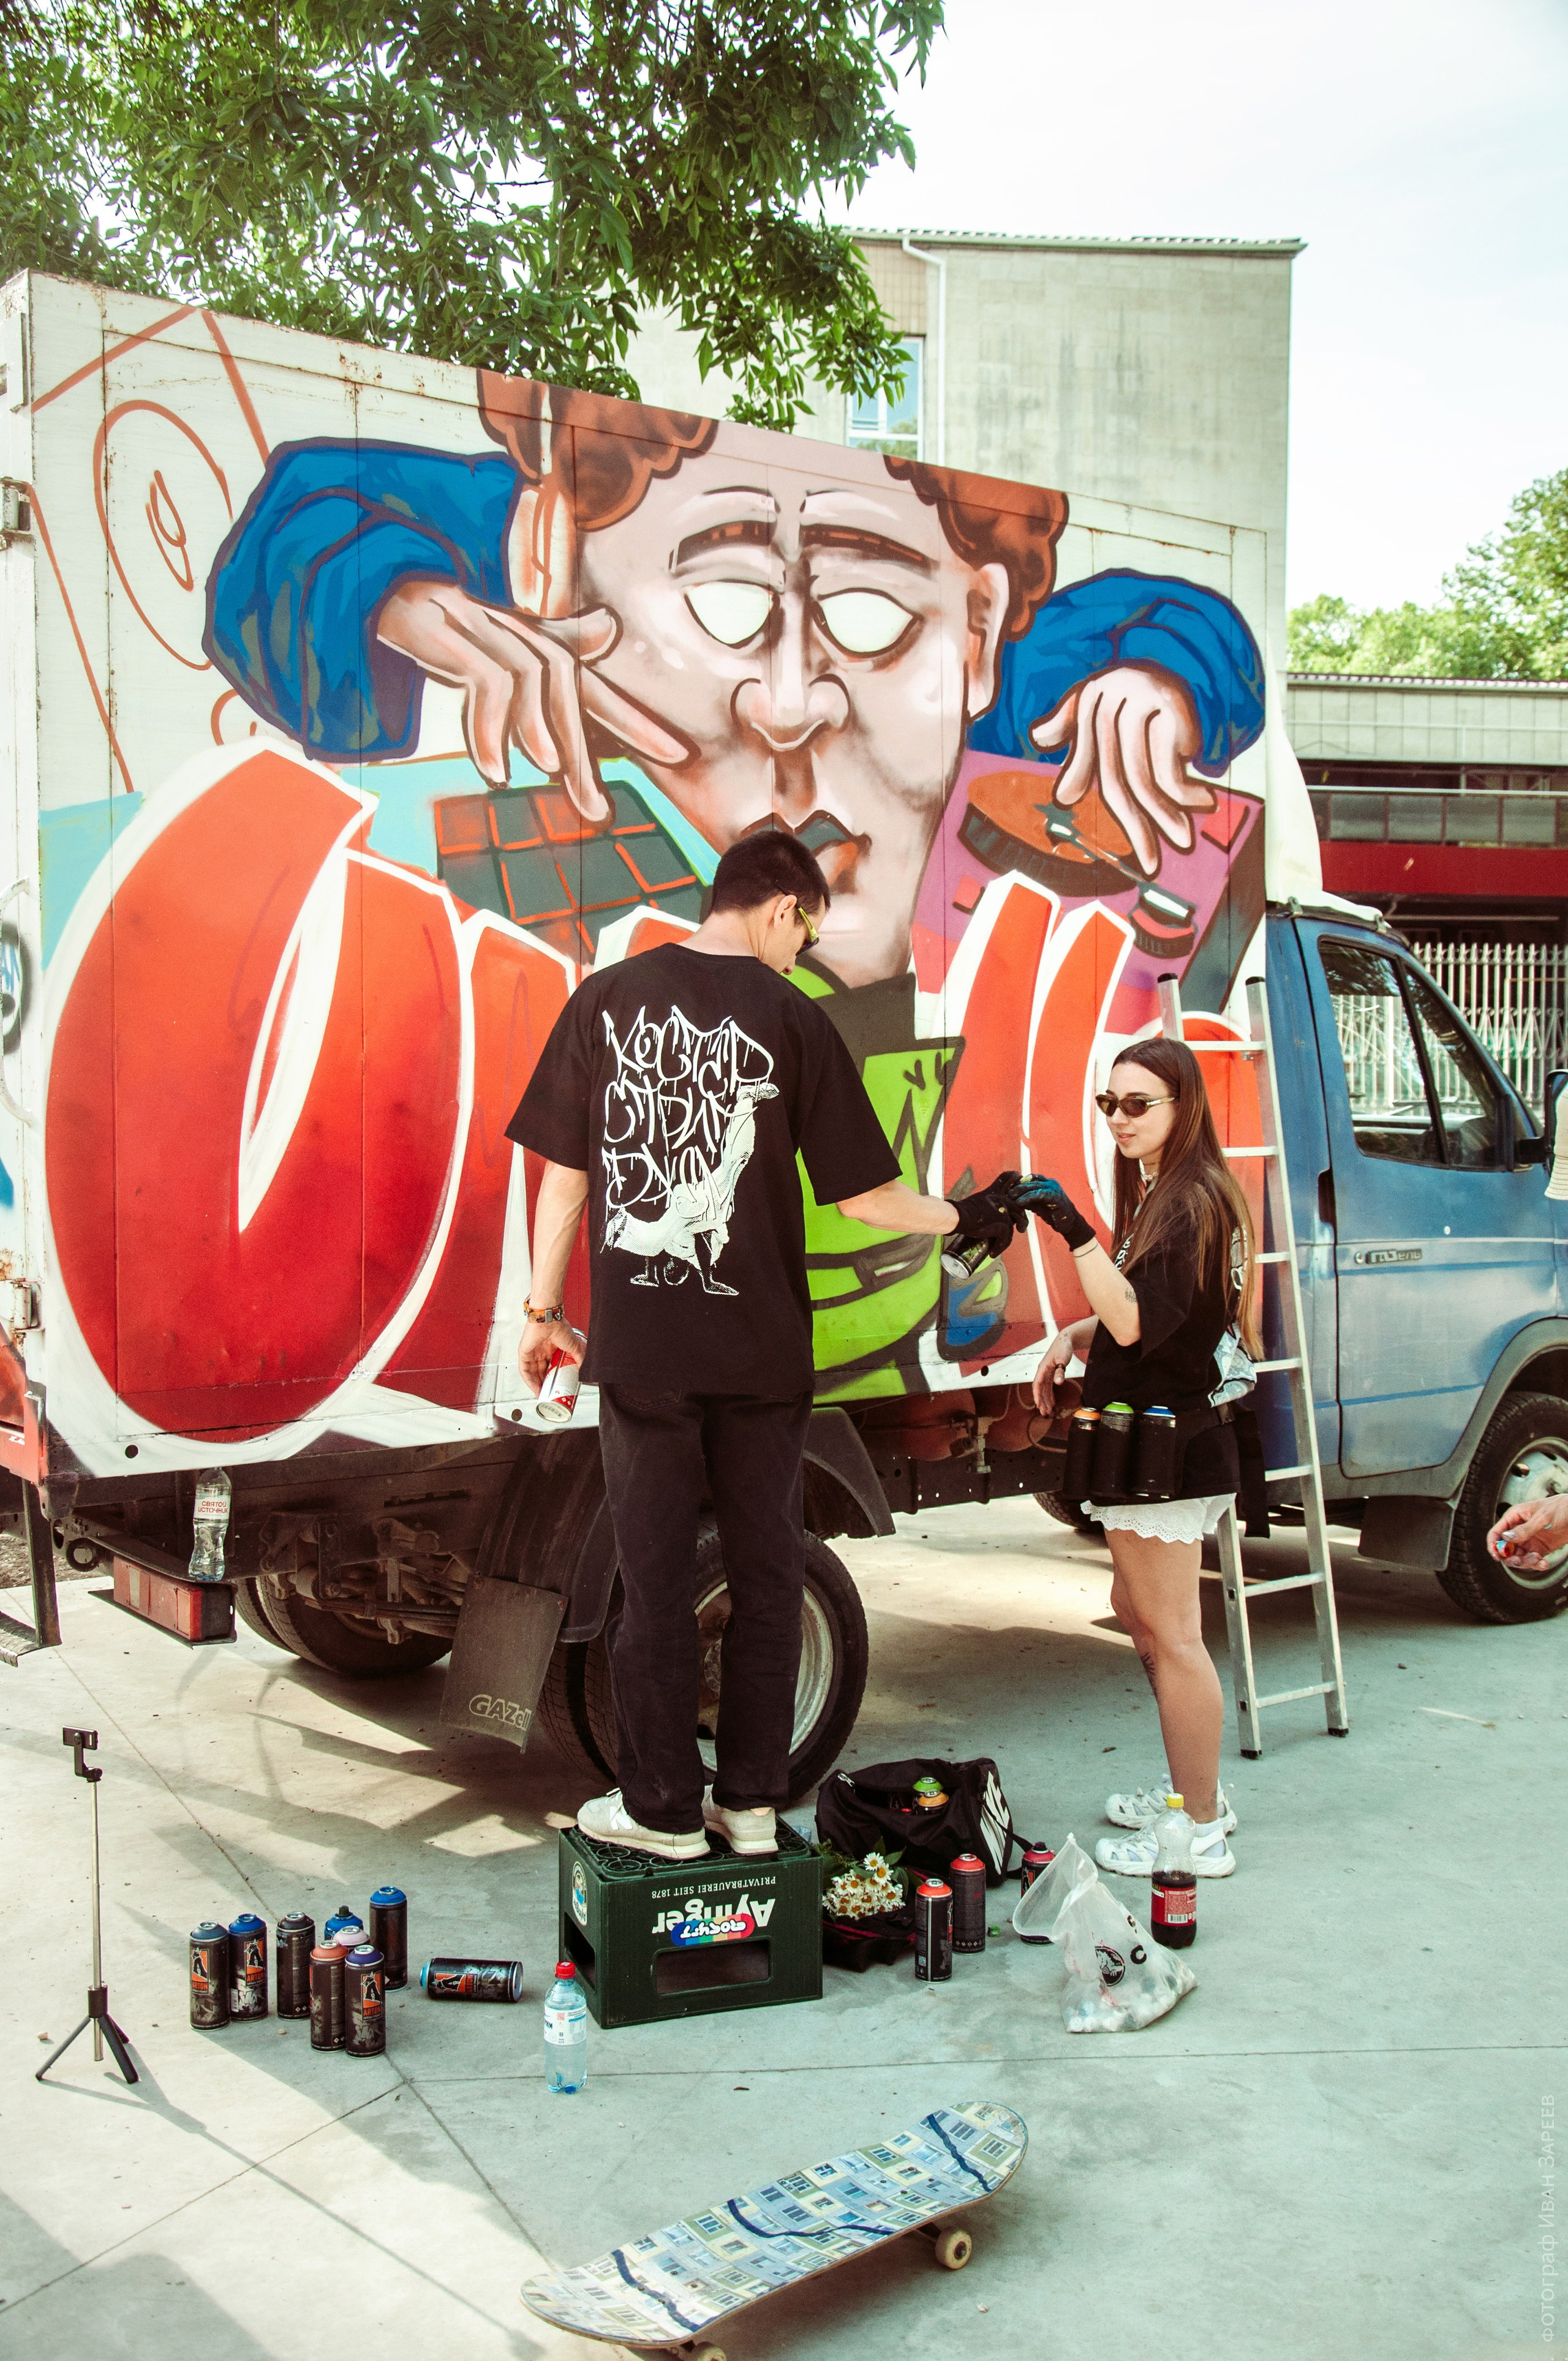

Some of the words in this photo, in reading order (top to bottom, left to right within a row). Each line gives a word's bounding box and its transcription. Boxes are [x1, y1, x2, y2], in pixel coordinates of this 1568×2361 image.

[697, 1875, 777, 1893] PRIVATBRAUEREI
[651, 1888, 672, 1899] 1878
[673, 1886, 695, 1897] SEIT
[363, 2006, 381, 2016] ARTON
